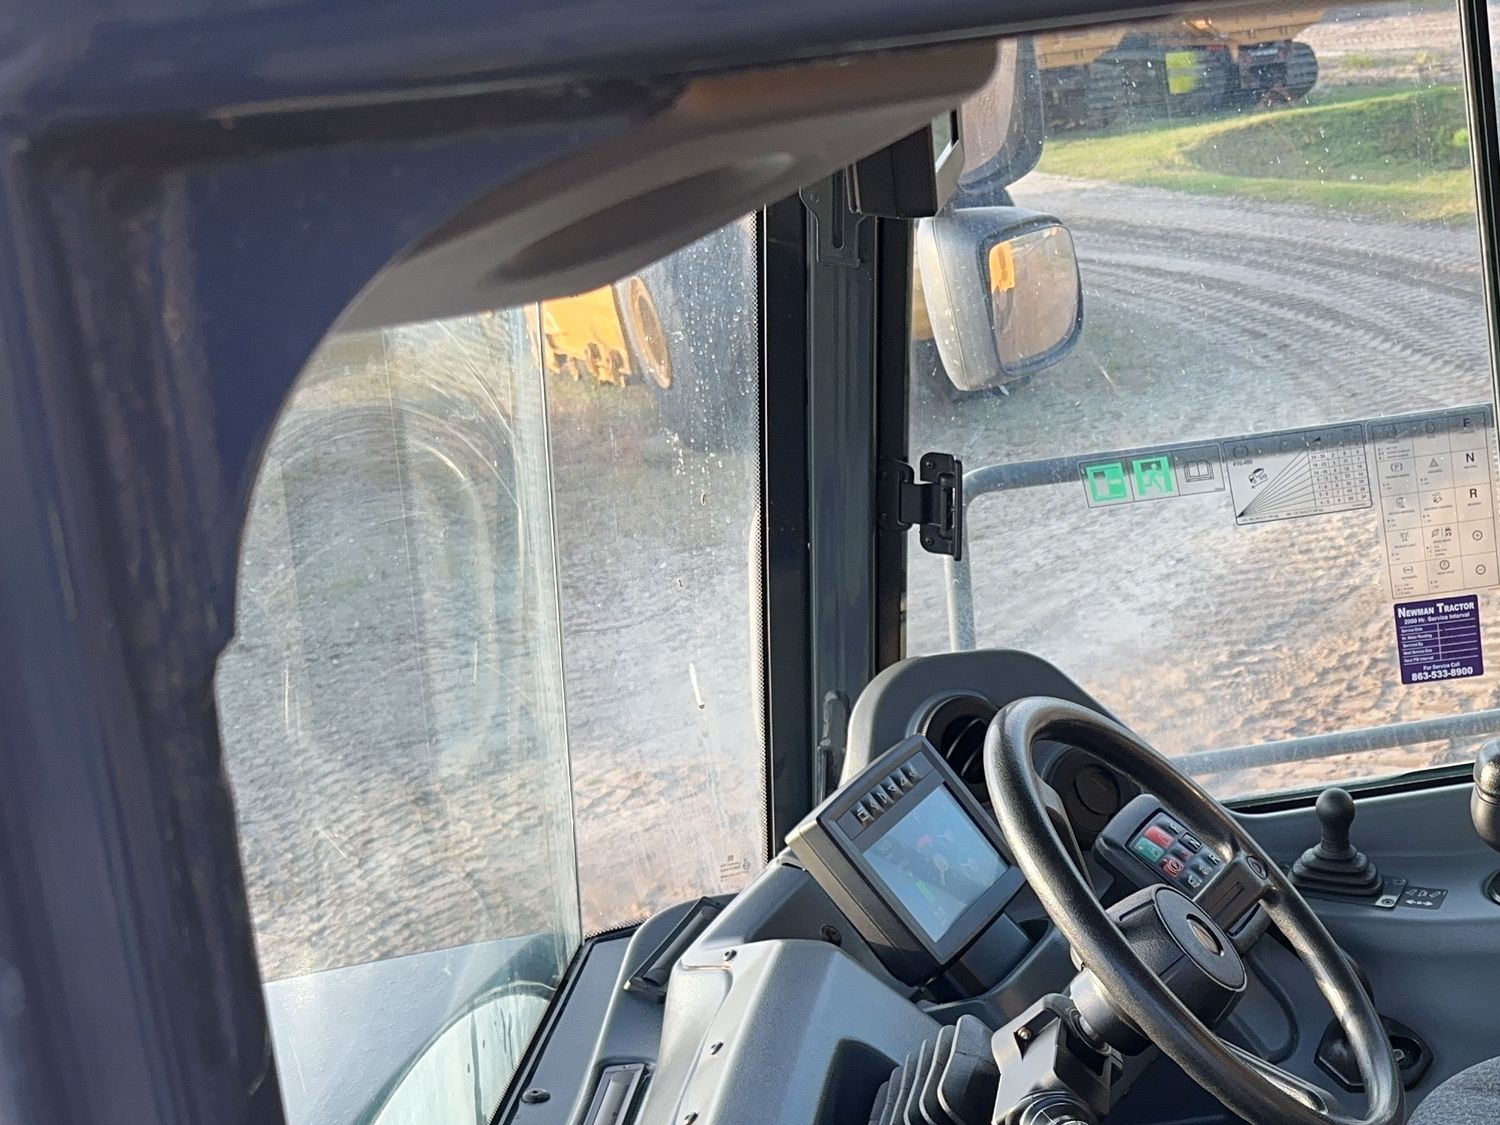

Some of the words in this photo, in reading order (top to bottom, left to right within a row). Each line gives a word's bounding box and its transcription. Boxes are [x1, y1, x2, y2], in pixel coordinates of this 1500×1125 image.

[1466, 452, 1475, 463] N
[1469, 488, 1478, 499] R
[1398, 607, 1434, 618] NEWMAN
[1436, 602, 1474, 613] TRACTOR
[1449, 612, 1470, 620] Interval
[1411, 667, 1473, 681] 863-533-8900
[1208, 853, 1220, 866] R
